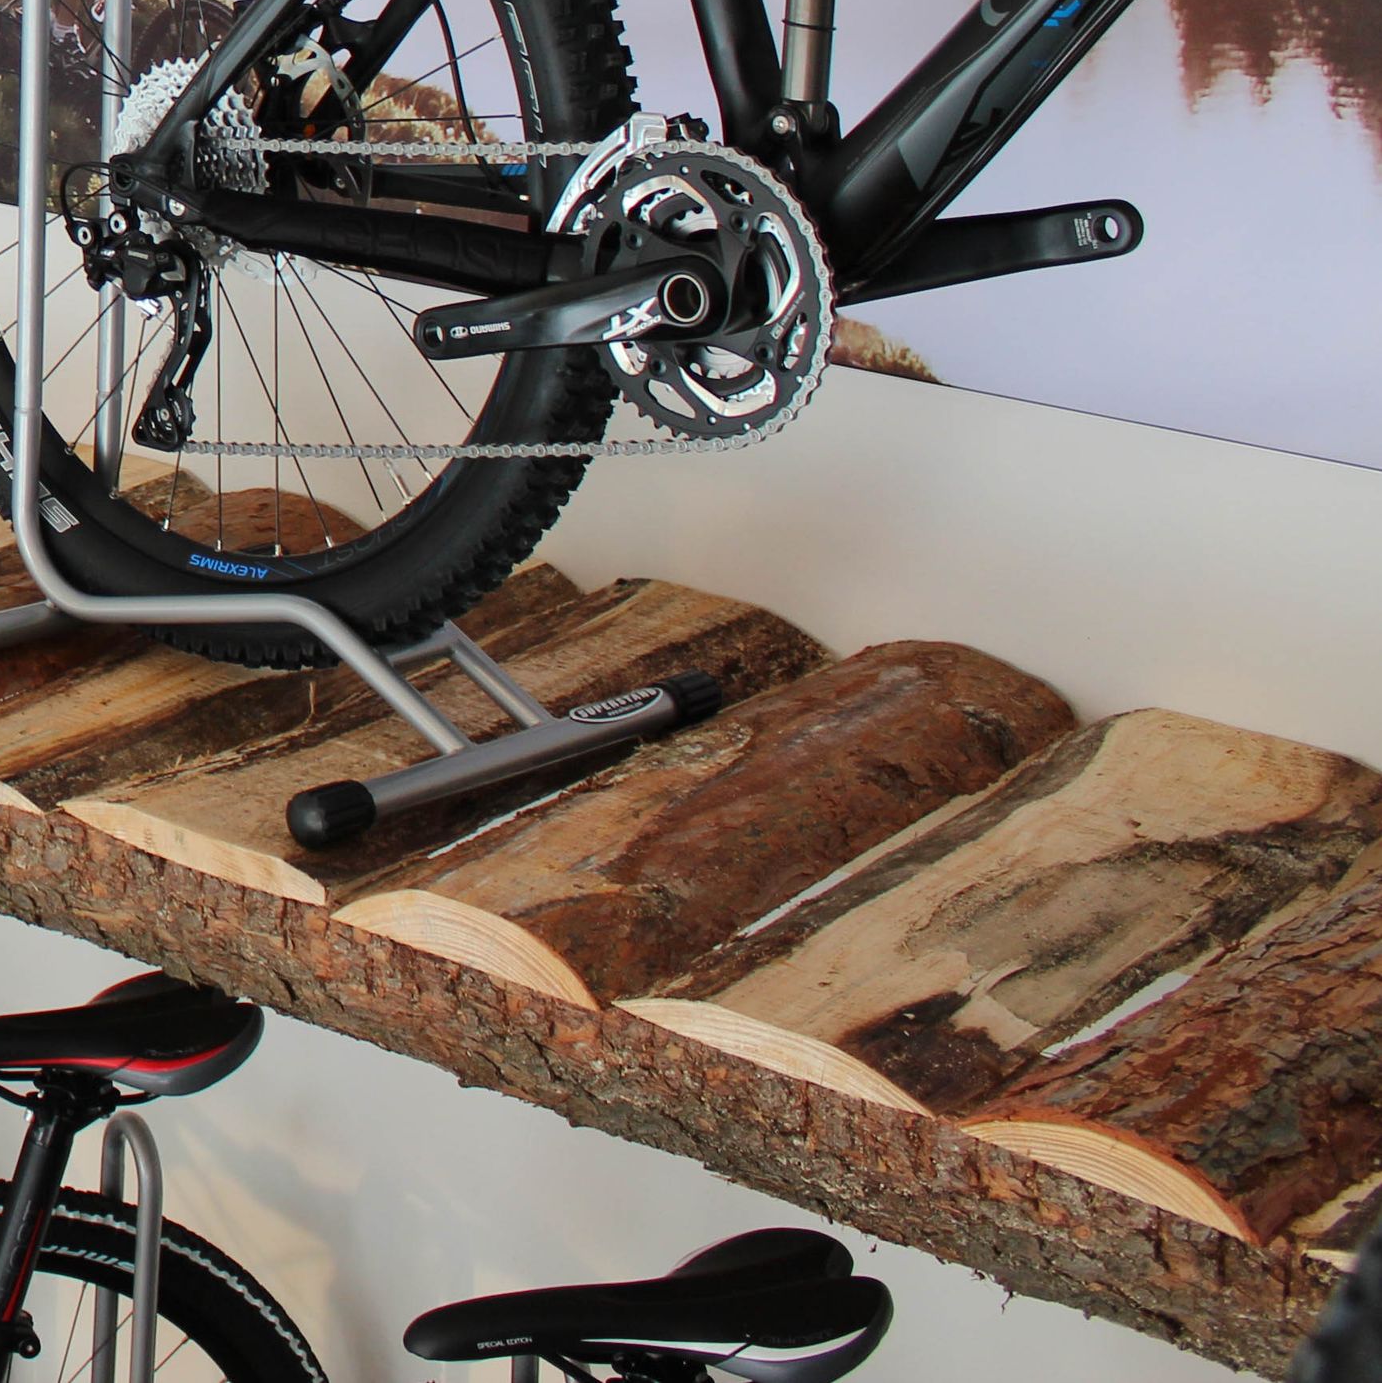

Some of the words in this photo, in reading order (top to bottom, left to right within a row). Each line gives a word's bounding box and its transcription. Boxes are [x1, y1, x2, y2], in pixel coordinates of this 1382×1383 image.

[470, 321, 512, 334] SHIMANO
[602, 295, 660, 341] XT
[189, 553, 269, 580] ALEXRIMS
[577, 686, 658, 719] SUPERSTAND
[37, 1244, 136, 1274] SMAR
[476, 1339, 506, 1351] SPECIAL
[505, 1336, 534, 1348] EDITION
